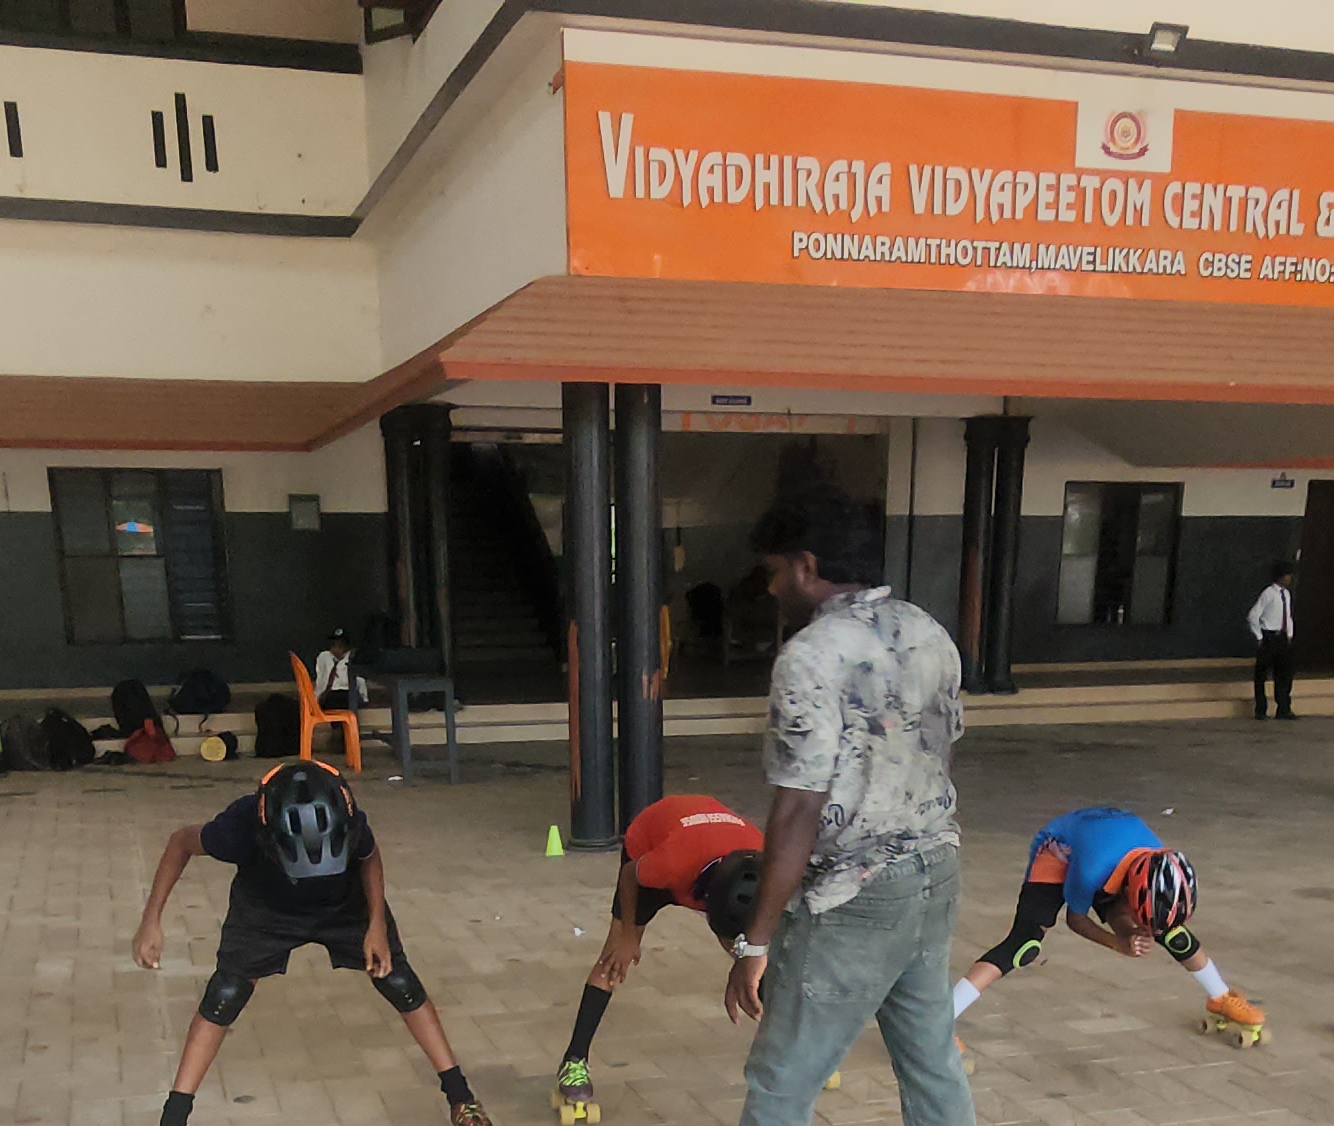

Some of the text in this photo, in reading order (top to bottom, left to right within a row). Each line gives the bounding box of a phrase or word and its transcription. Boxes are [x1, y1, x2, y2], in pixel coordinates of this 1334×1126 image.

[597, 110, 892, 224] VIDYADHIRAJA
[908, 163, 1152, 227] VIDYAPEETOM
[1163, 181, 1306, 240] CENTRAL
[1198, 251, 1253, 279] CBSE
